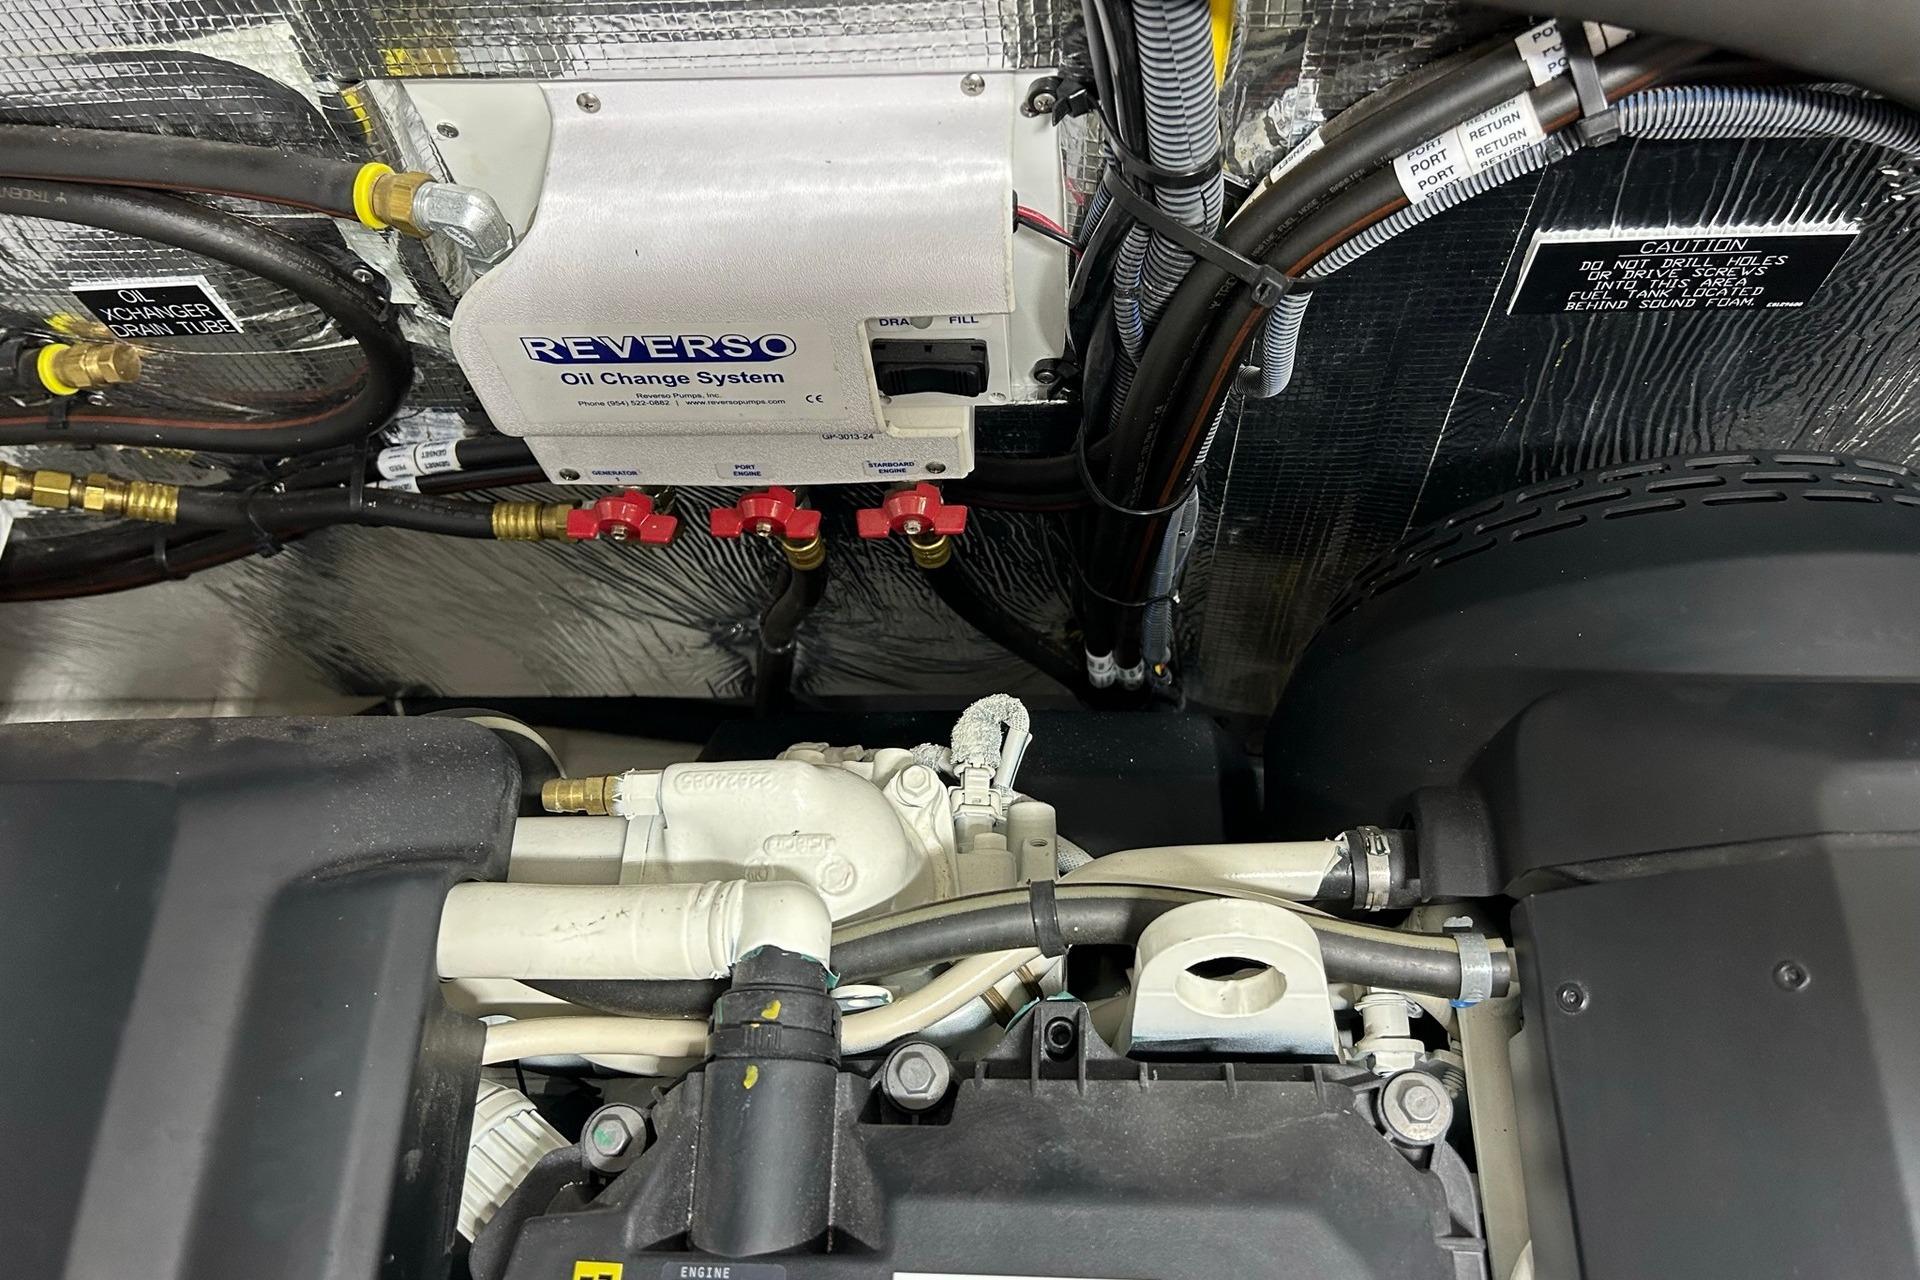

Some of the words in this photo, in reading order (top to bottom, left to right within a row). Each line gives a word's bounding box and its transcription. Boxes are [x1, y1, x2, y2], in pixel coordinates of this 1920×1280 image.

[1469, 111, 1521, 141] RETURN
[1407, 136, 1442, 161] PORT
[1475, 128, 1527, 157] RETURN
[1278, 139, 1312, 171] GENSET
[1410, 148, 1448, 176] PORT
[1417, 165, 1455, 191] PORT
[1640, 239, 1749, 254] CAUTION
[1579, 260, 1604, 271] DO
[1613, 259, 1650, 270] NOT
[1661, 257, 1713, 268] DRILL
[1727, 255, 1789, 266] HOLES
[1588, 271, 1612, 280] OR
[1622, 269, 1682, 279] DRIVE
[1692, 266, 1768, 278] SCREWS
[1594, 281, 1637, 290] INTO
[1650, 279, 1690, 289] THIS
[1700, 278, 1747, 287] AREA
[118, 289, 155, 303] OIL
[1568, 291, 1612, 300] FUEL
[1628, 289, 1672, 299] TANK
[1682, 287, 1764, 297] LOCATED
[99, 304, 215, 321] XCHANGER
[1564, 300, 1628, 311] BEHIND
[1639, 299, 1696, 309] SOUND
[1705, 298, 1755, 307] FOAM.
[108, 322, 174, 338] DRAIN
[176, 319, 236, 334] TUBE
[879, 318, 912, 327] DRA
[949, 316, 979, 325] FILL
[520, 333, 796, 364] REVERSO
[561, 372, 594, 385] Oil
[600, 372, 690, 387] Change
[697, 371, 784, 387] System
[680, 1266, 731, 1279] ENGINE
